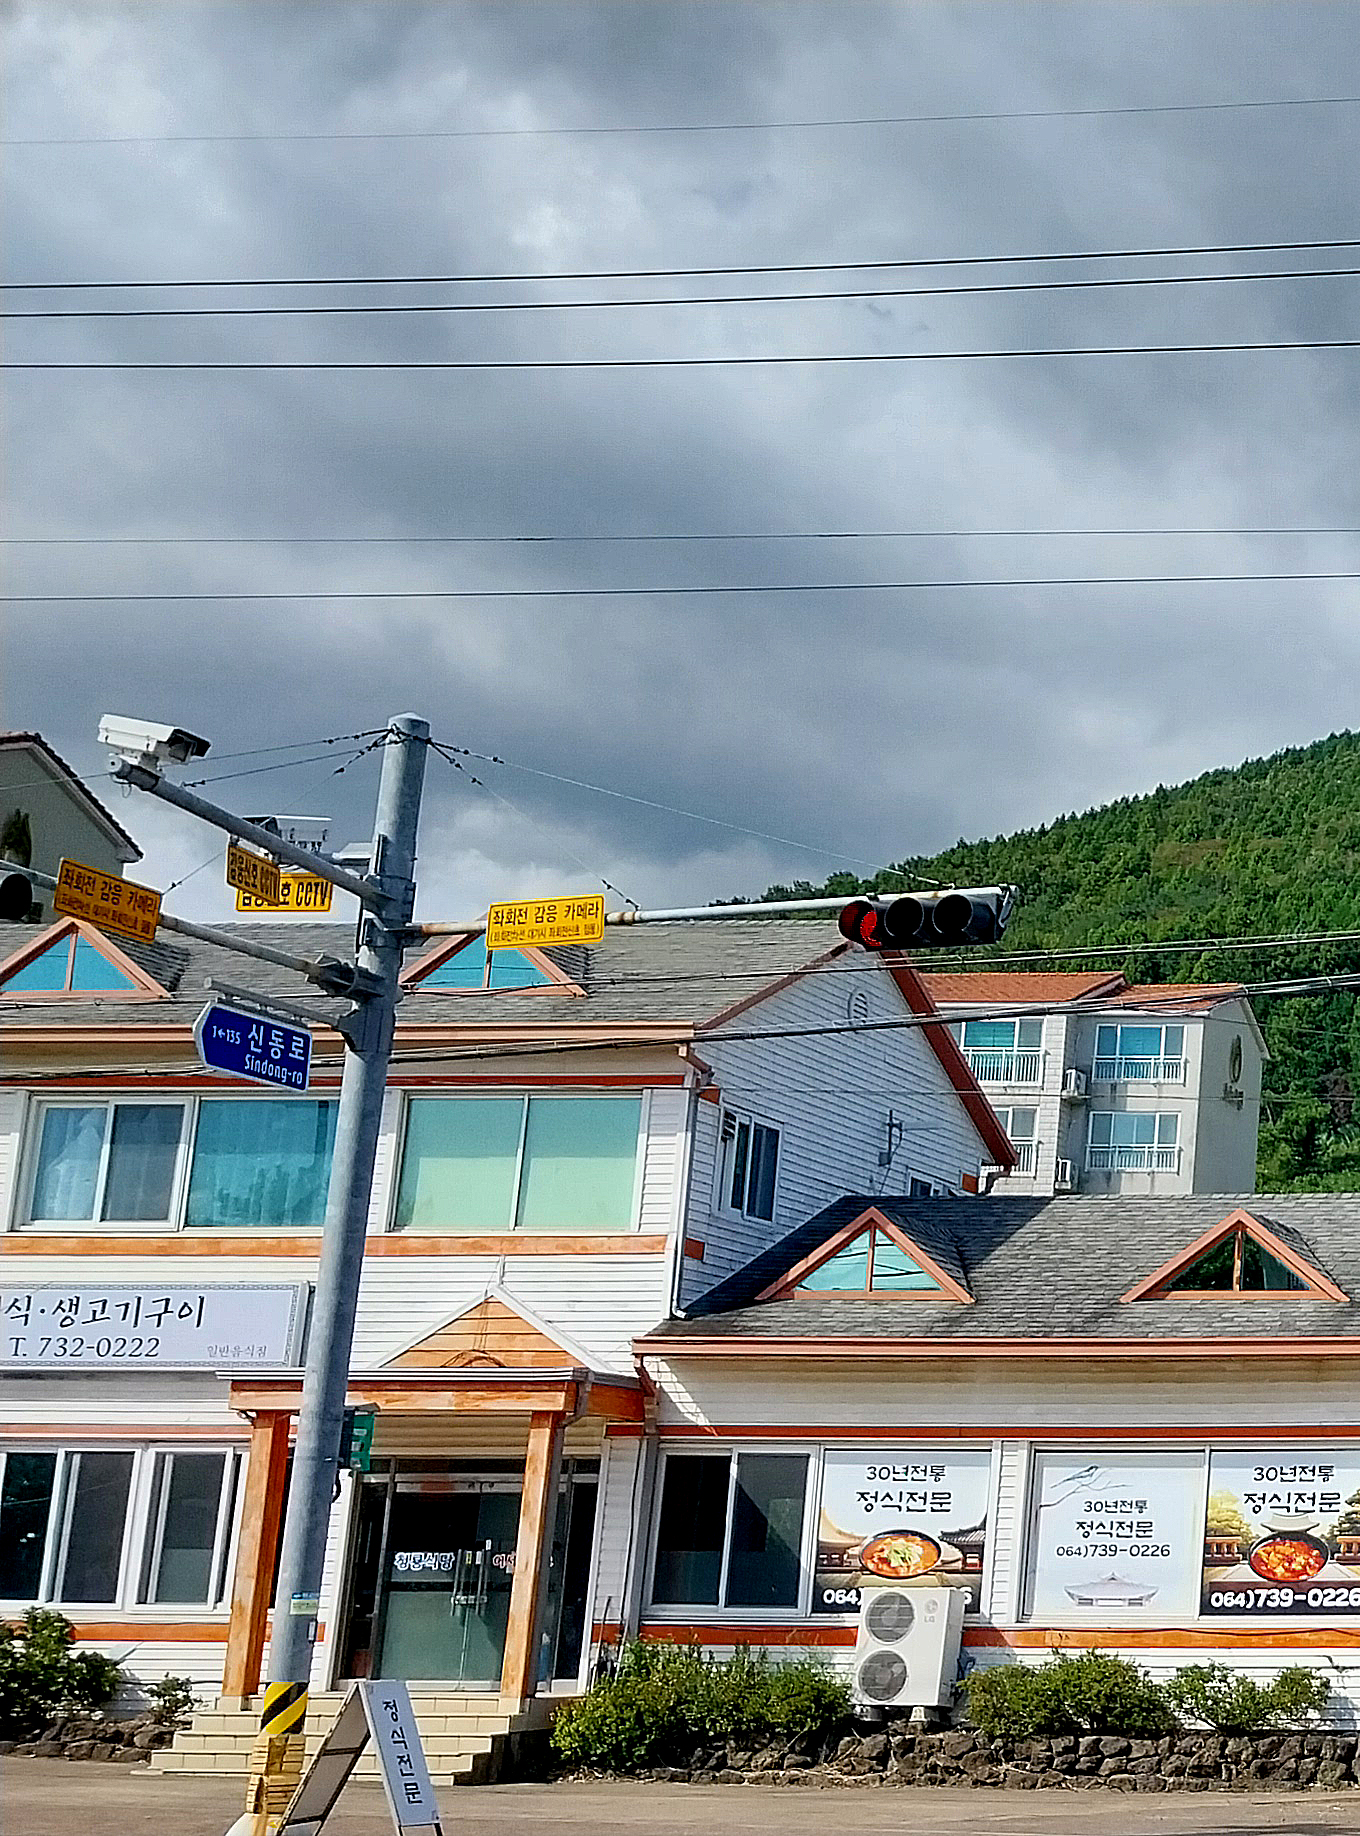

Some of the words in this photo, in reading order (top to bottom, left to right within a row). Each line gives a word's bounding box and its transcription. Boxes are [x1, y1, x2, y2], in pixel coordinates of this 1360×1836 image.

[62, 868, 96, 897] 좌회전
[101, 880, 122, 906] 감응
[127, 891, 158, 917] 카메라
[296, 881, 329, 907] CCTV
[493, 907, 528, 927] 좌회전
[535, 904, 558, 924] 감응
[564, 901, 599, 921] 카메라
[248, 1023, 305, 1061] 신동로
[245, 1054, 303, 1084] Sindong-ro
[0, 1295, 205, 1329] 식·생고기구이
[9, 1337, 28, 1358] T.
[38, 1337, 160, 1358] 732-0222
[866, 1465, 946, 1483] 30년전통
[1254, 1465, 1334, 1483] 30년전통
[856, 1490, 952, 1513] 정식전문
[1083, 1500, 1148, 1514] 30년전통
[1243, 1492, 1341, 1514] 정식전문
[1076, 1520, 1154, 1539] 정식전문
[1056, 1544, 1171, 1558] 064)739-0226
[924, 1615, 936, 1623] LG
[382, 1699, 423, 1805] 정식전문
